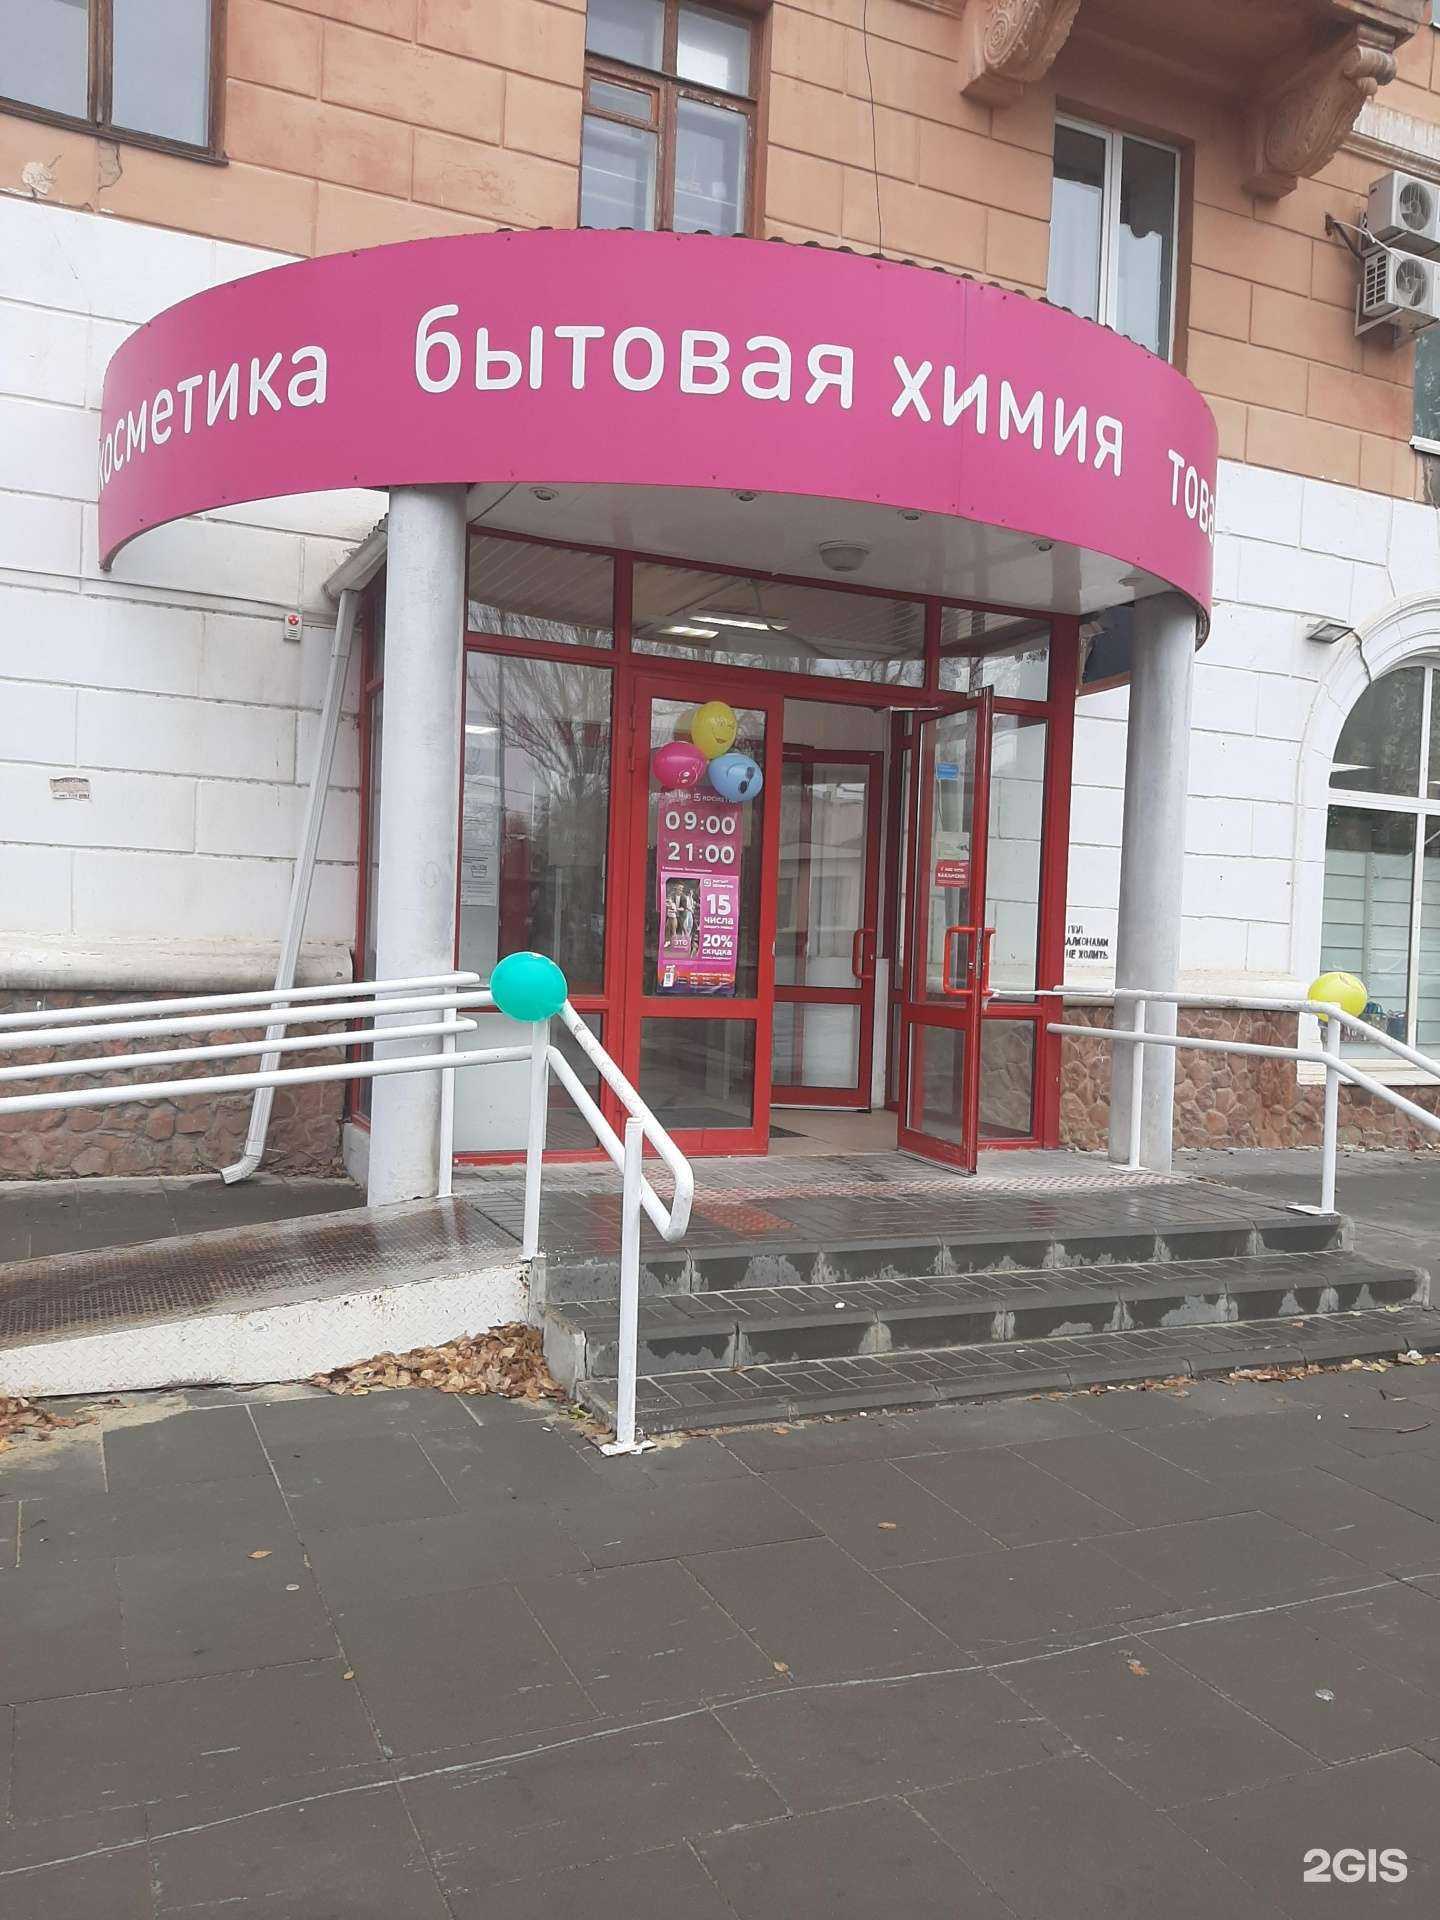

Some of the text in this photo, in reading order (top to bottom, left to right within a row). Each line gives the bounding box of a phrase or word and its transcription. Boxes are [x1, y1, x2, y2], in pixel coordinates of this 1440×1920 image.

[414, 304, 854, 410] бытовая
[891, 354, 1124, 477] химия
[665, 810, 736, 835] 09:00
[667, 841, 735, 864] 21:00
[706, 893, 731, 915] 15
[703, 916, 734, 925] числа
[702, 934, 733, 948] 20%
[702, 948, 733, 956] скидка
